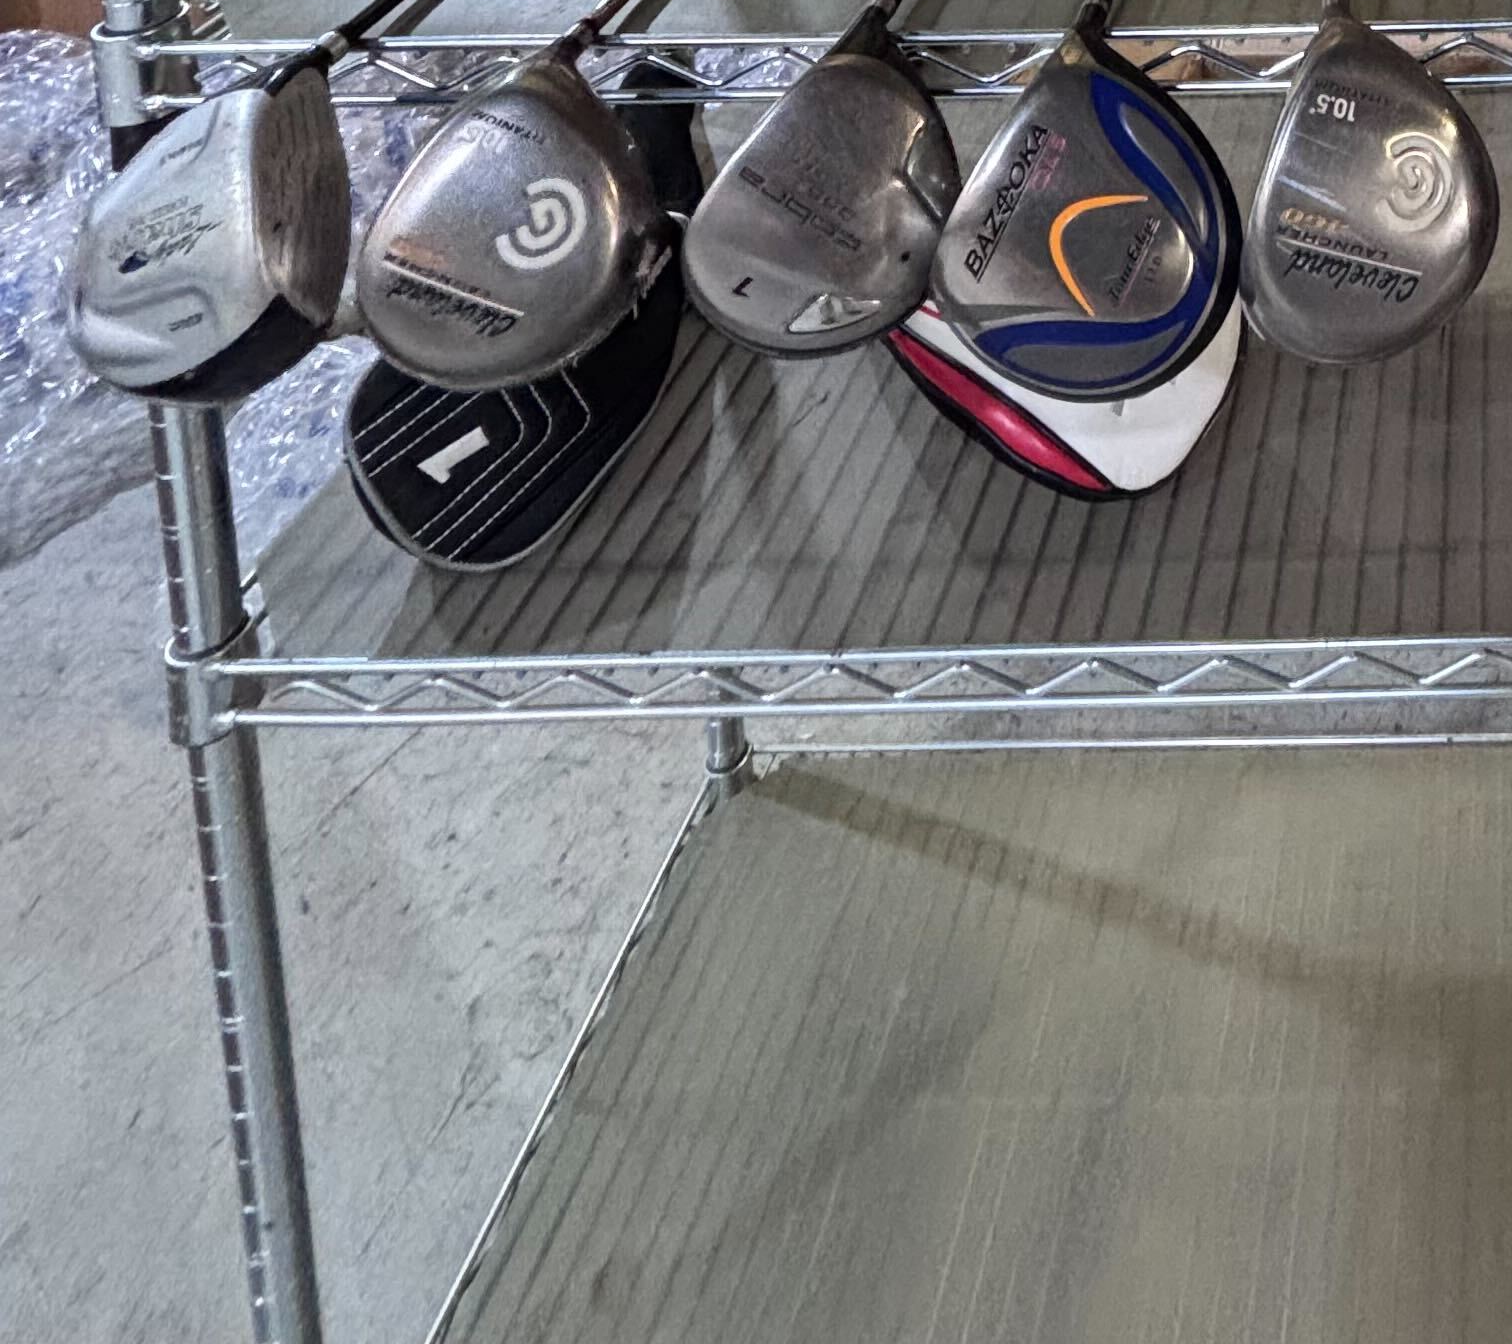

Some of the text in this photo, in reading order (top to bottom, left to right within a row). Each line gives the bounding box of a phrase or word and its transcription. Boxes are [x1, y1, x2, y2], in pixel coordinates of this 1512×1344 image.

[738, 166, 863, 251] cobra
[1276, 224, 1389, 261] LAUNCHER
[1283, 246, 1421, 303] Cleveland
[416, 425, 491, 485] 1
